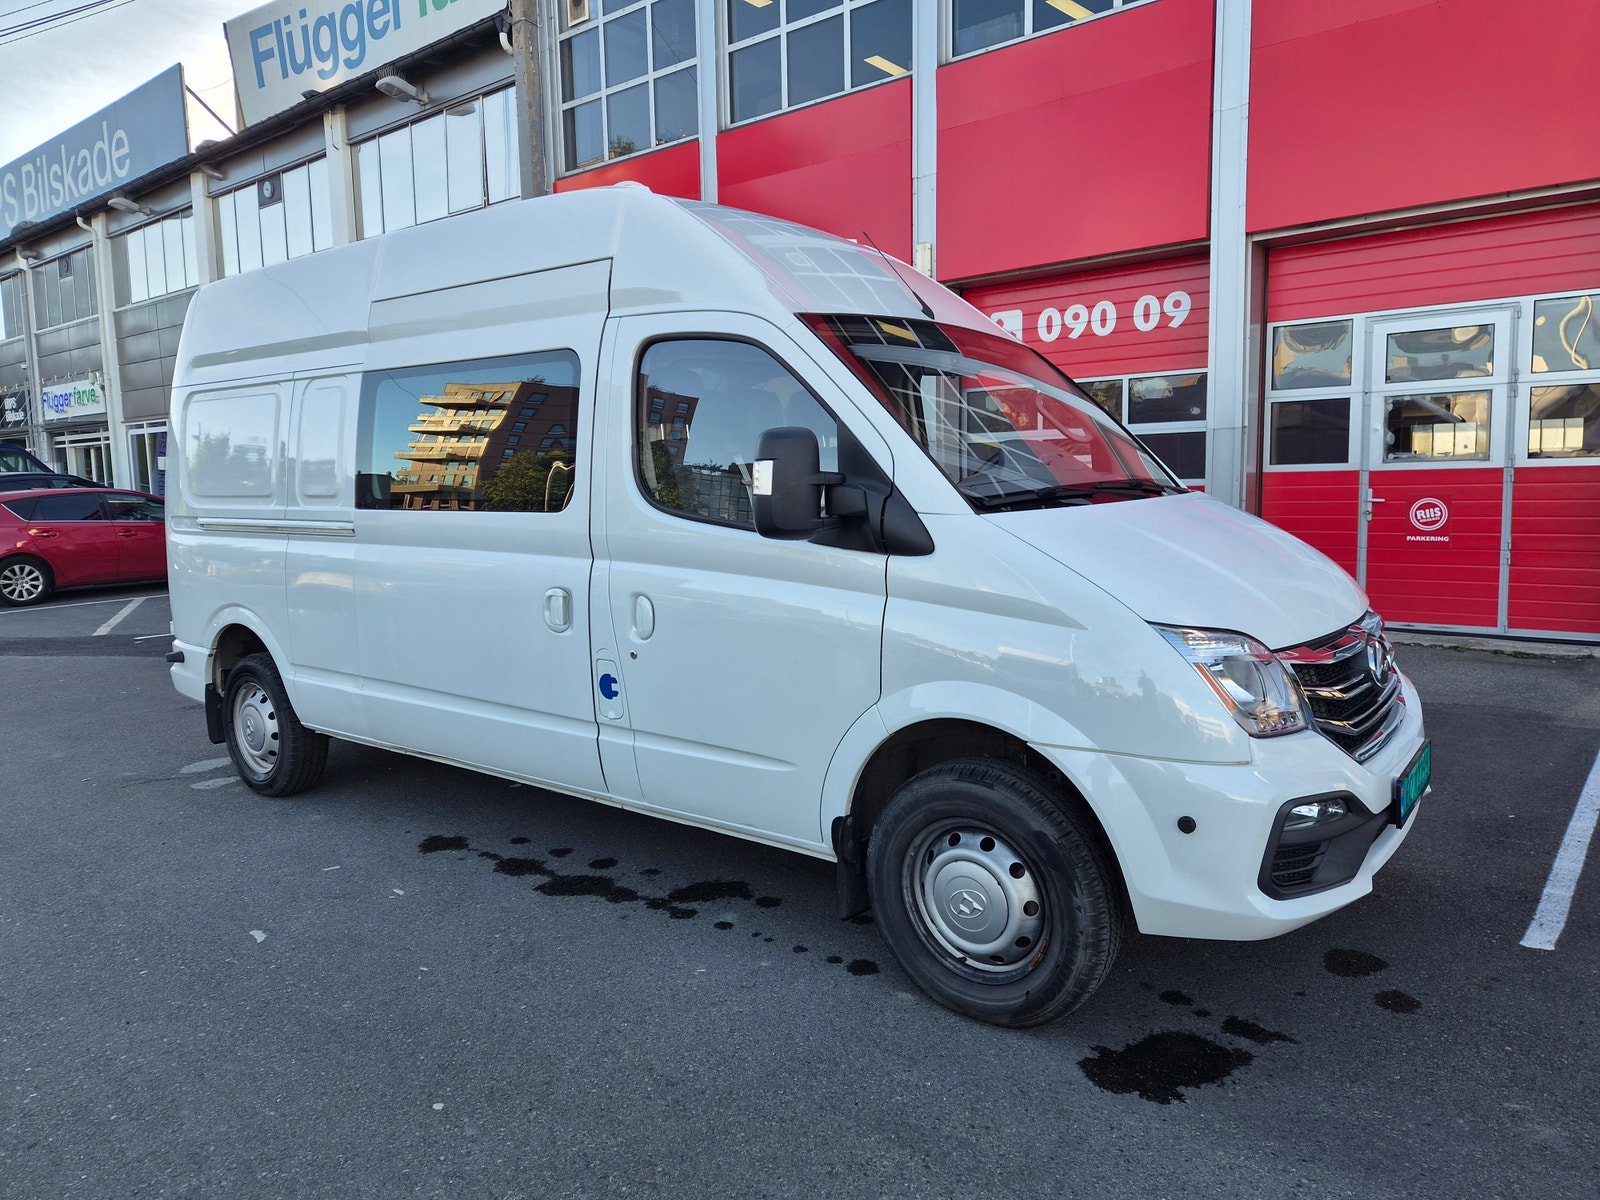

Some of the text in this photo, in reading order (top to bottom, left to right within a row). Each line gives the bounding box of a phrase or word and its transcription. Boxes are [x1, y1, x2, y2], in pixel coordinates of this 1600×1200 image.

[249, 0, 401, 89] Flügger
[0, 120, 130, 228] S Bilskade
[1037, 290, 1192, 342] 090 09
[73, 386, 96, 405] farve
[1416, 507, 1441, 520] RIIS
